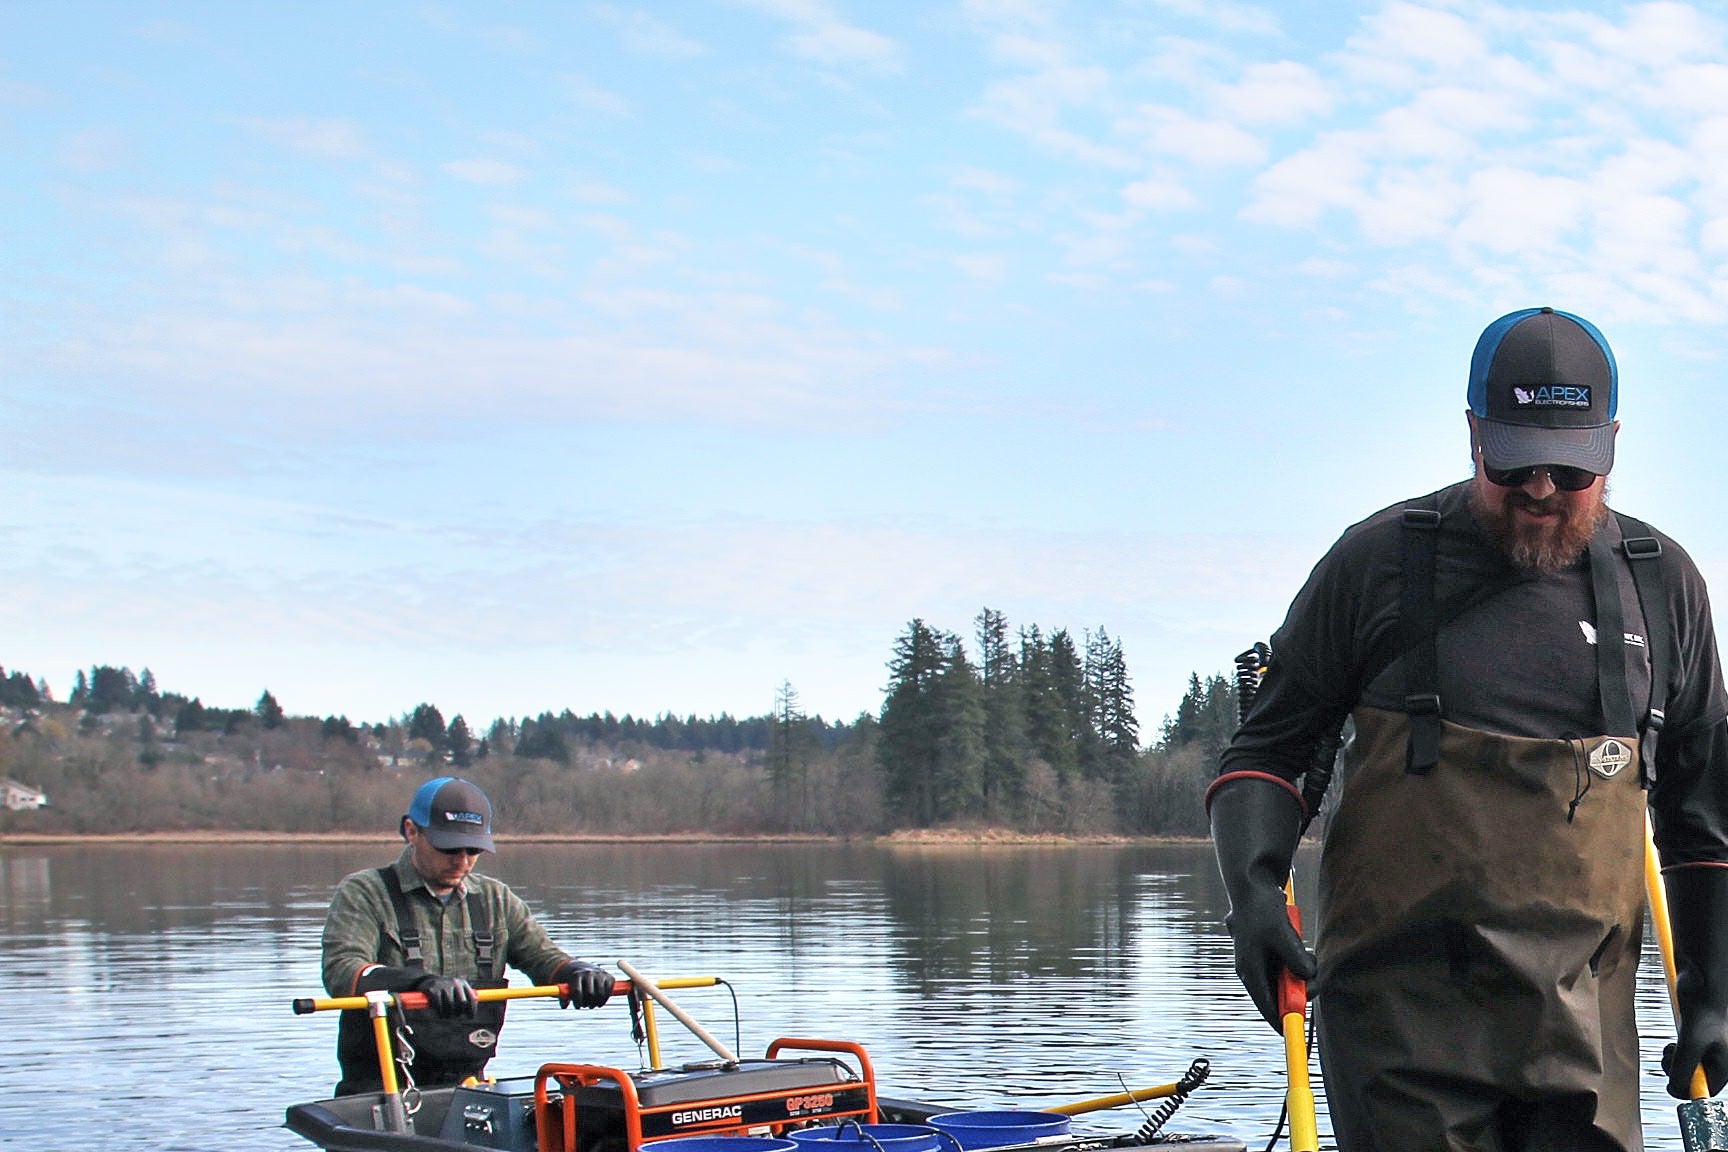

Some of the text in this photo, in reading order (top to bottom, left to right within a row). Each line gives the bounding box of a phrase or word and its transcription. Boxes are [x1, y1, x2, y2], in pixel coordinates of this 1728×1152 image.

[1535, 386, 1589, 401] APEX
[786, 1093, 833, 1111] GP3250
[672, 1105, 742, 1124] GENERAC
